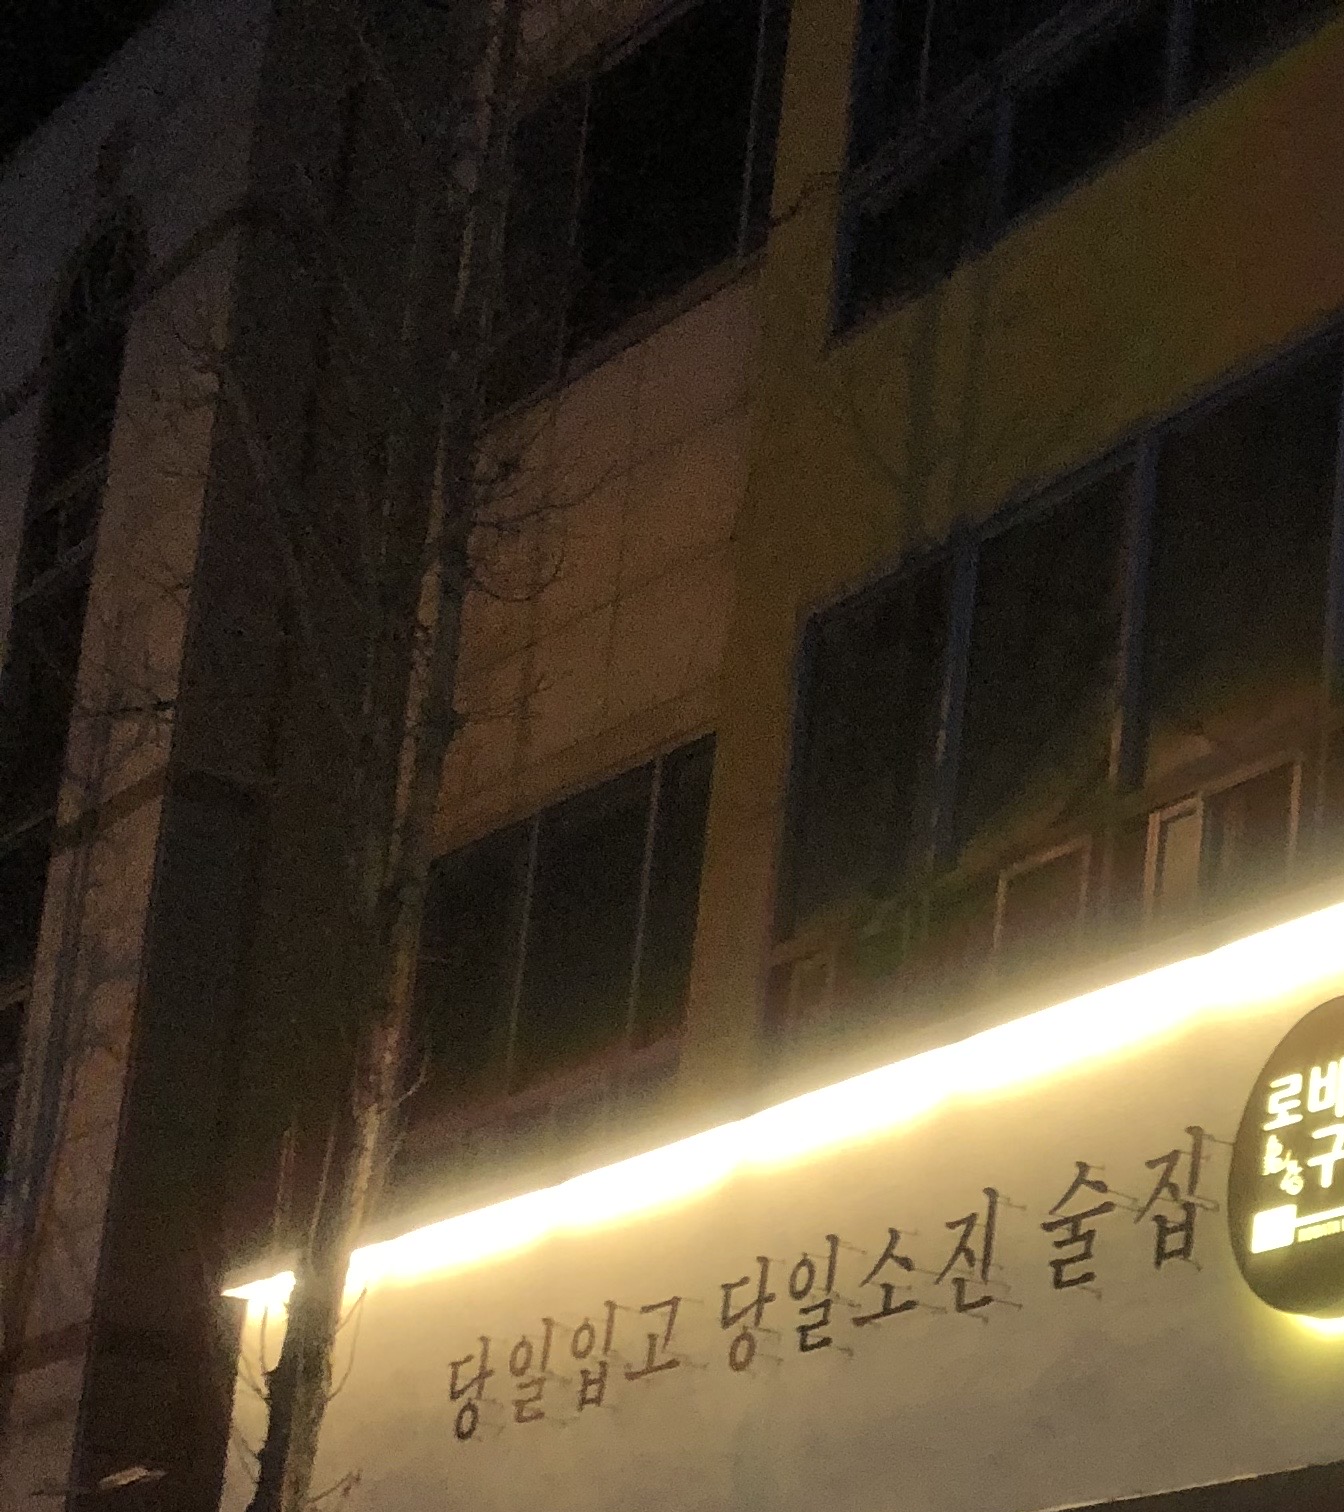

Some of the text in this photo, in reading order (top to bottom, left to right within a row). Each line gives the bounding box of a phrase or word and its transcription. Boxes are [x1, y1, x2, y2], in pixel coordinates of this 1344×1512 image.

[448, 1125, 1206, 1440] 당일입고 당일소진 술집
